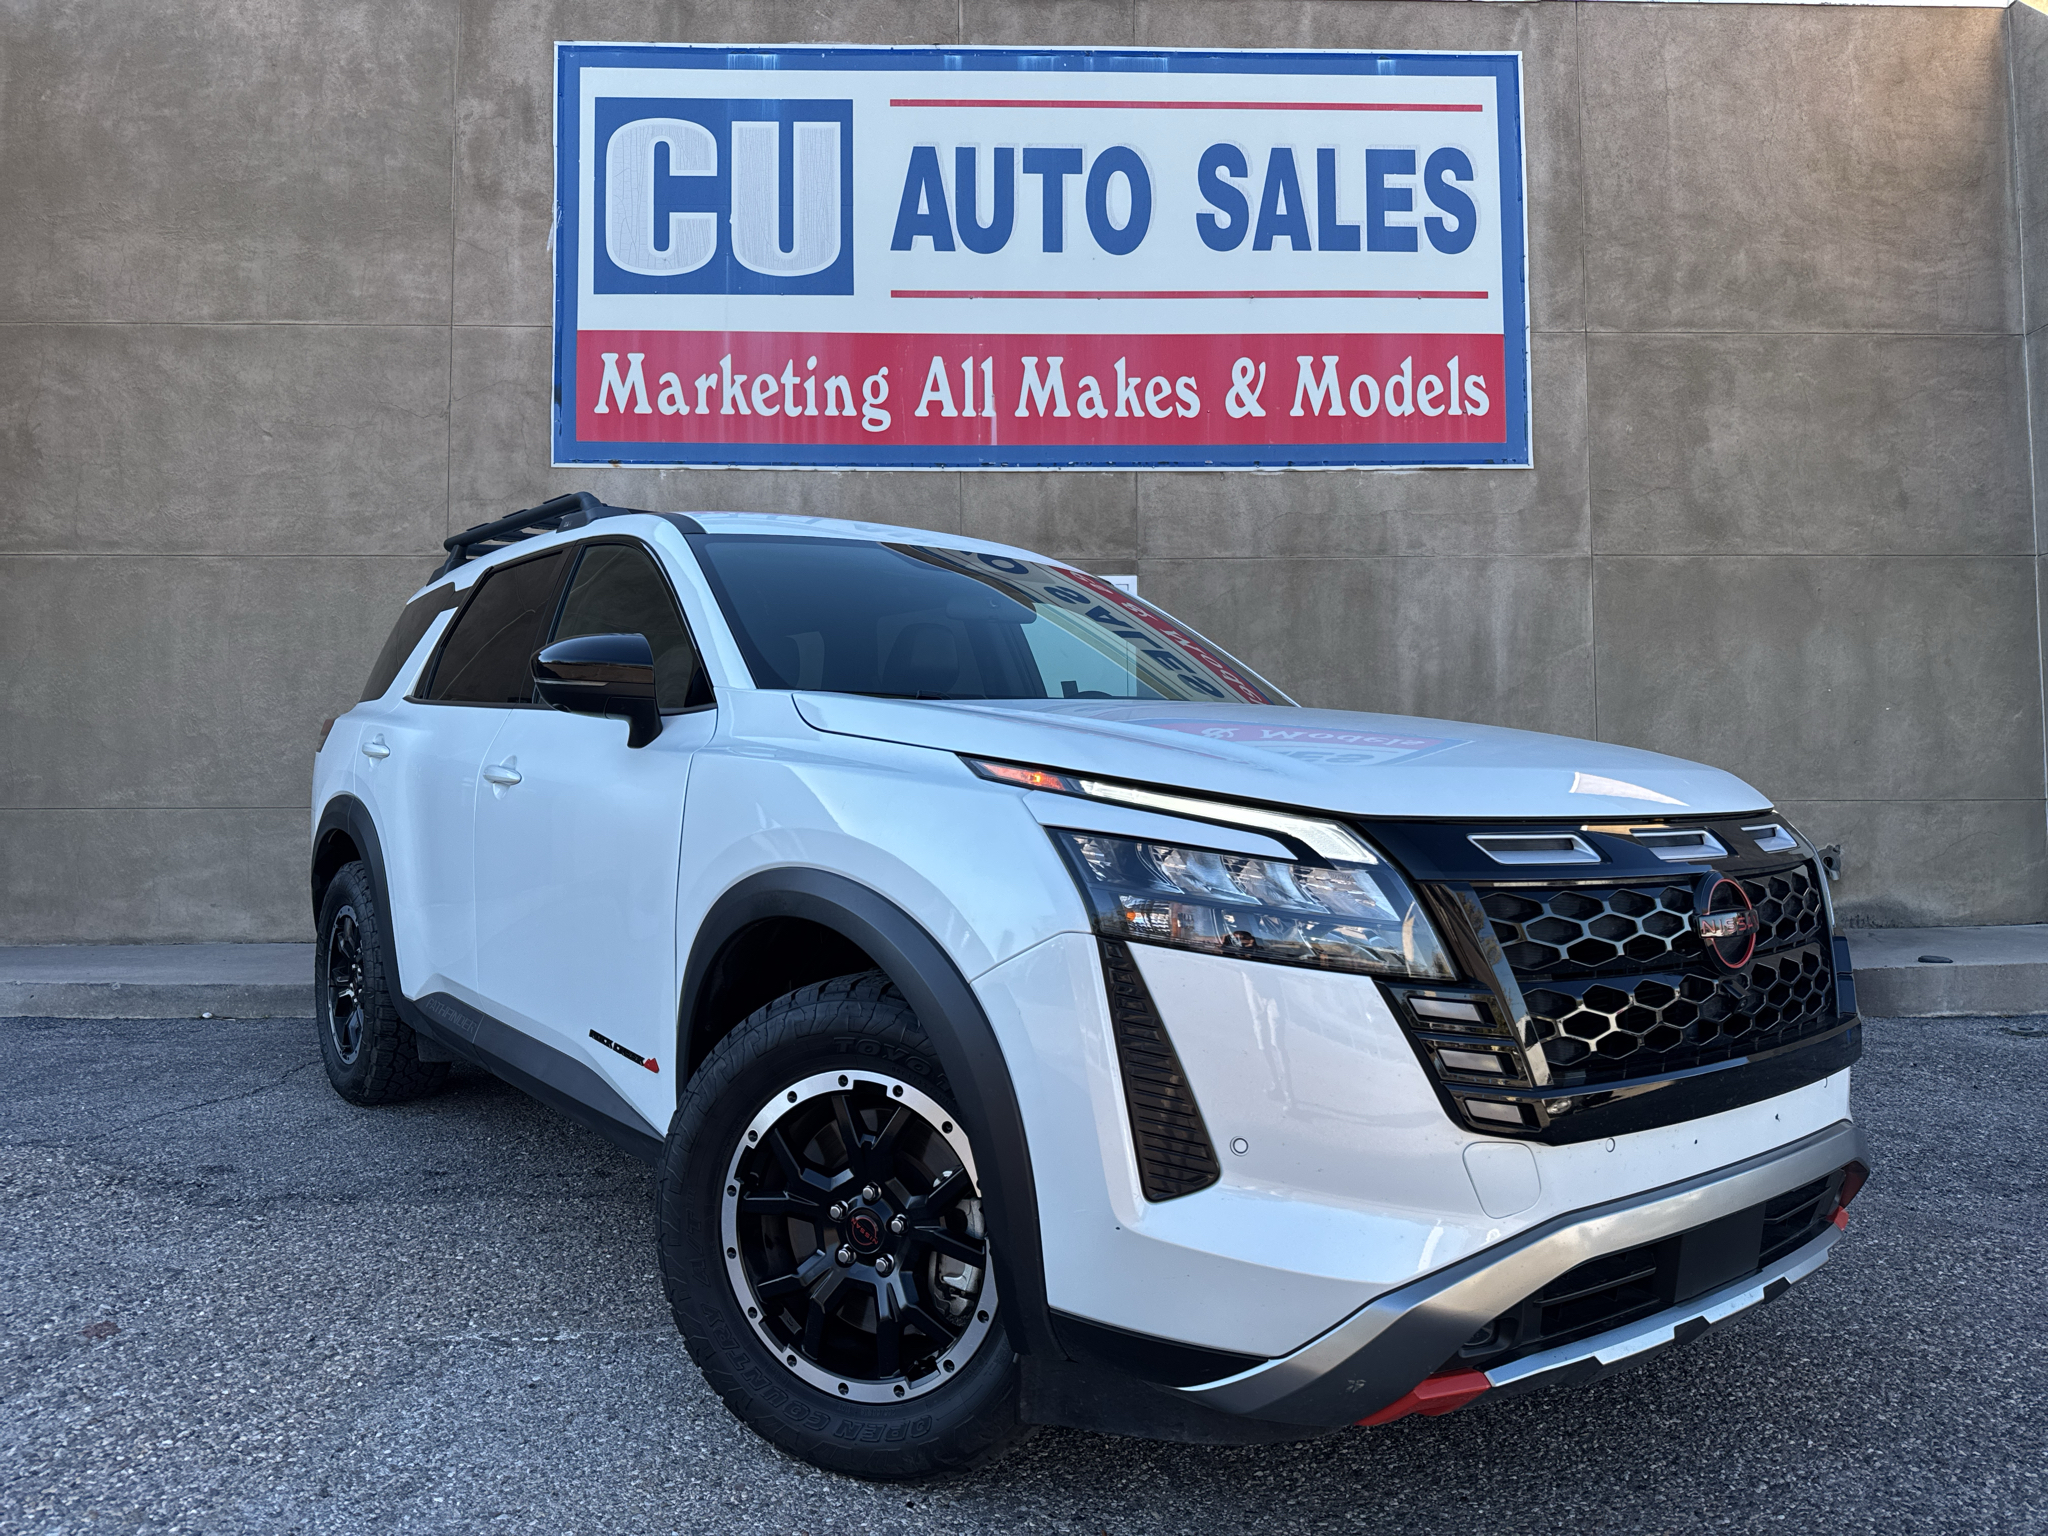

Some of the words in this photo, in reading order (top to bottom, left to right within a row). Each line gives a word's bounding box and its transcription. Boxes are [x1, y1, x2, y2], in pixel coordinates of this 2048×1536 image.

[606, 118, 841, 276] CU
[890, 145, 1152, 255] AUTO
[1195, 143, 1478, 255] SALES
[594, 352, 891, 432] Marketing
[914, 355, 995, 417] All
[1014, 356, 1200, 419] Makes
[1225, 356, 1267, 418] &
[1290, 355, 1490, 417] Models
[1700, 914, 1759, 935] NISSAN
[425, 997, 477, 1034] PATHFINDER
[833, 1036, 932, 1076] TOYO
[850, 1216, 879, 1245] NISSAN
[701, 1304, 830, 1431] COUNTRY
[833, 1415, 932, 1443] OPEN
